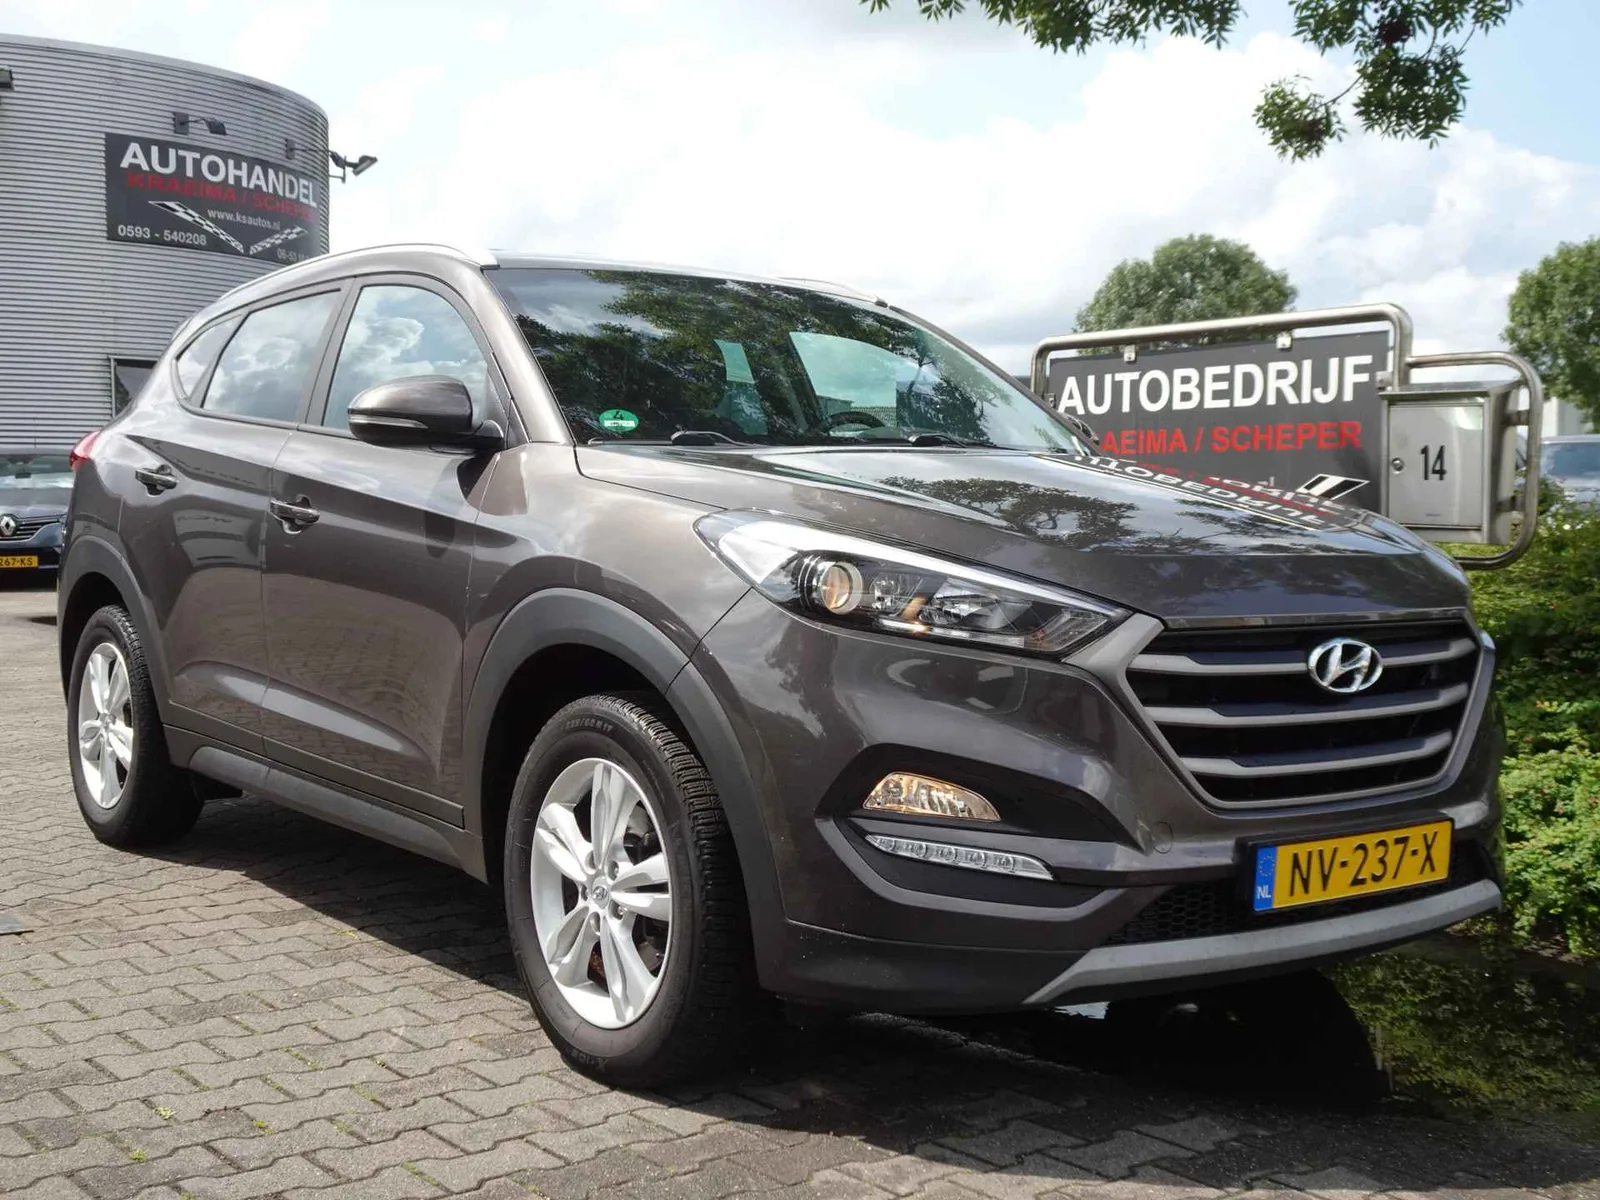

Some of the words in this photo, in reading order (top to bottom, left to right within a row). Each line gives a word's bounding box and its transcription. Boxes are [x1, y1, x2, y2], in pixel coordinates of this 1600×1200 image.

[120, 142, 317, 208] AUTOHANDEL
[127, 172, 237, 203] KRAEIMA
[118, 225, 151, 239] 0593
[163, 230, 207, 246] 540208
[207, 209, 281, 230] www.ksautos.nl
[1058, 355, 1373, 415] AUTOBEDRIJF
[1096, 428, 1187, 455] AEIMA
[1210, 421, 1361, 453] SCHEPER
[1420, 445, 1447, 480] 14
[1289, 830, 1439, 897] NV-237-X
[1256, 884, 1272, 899] NL
